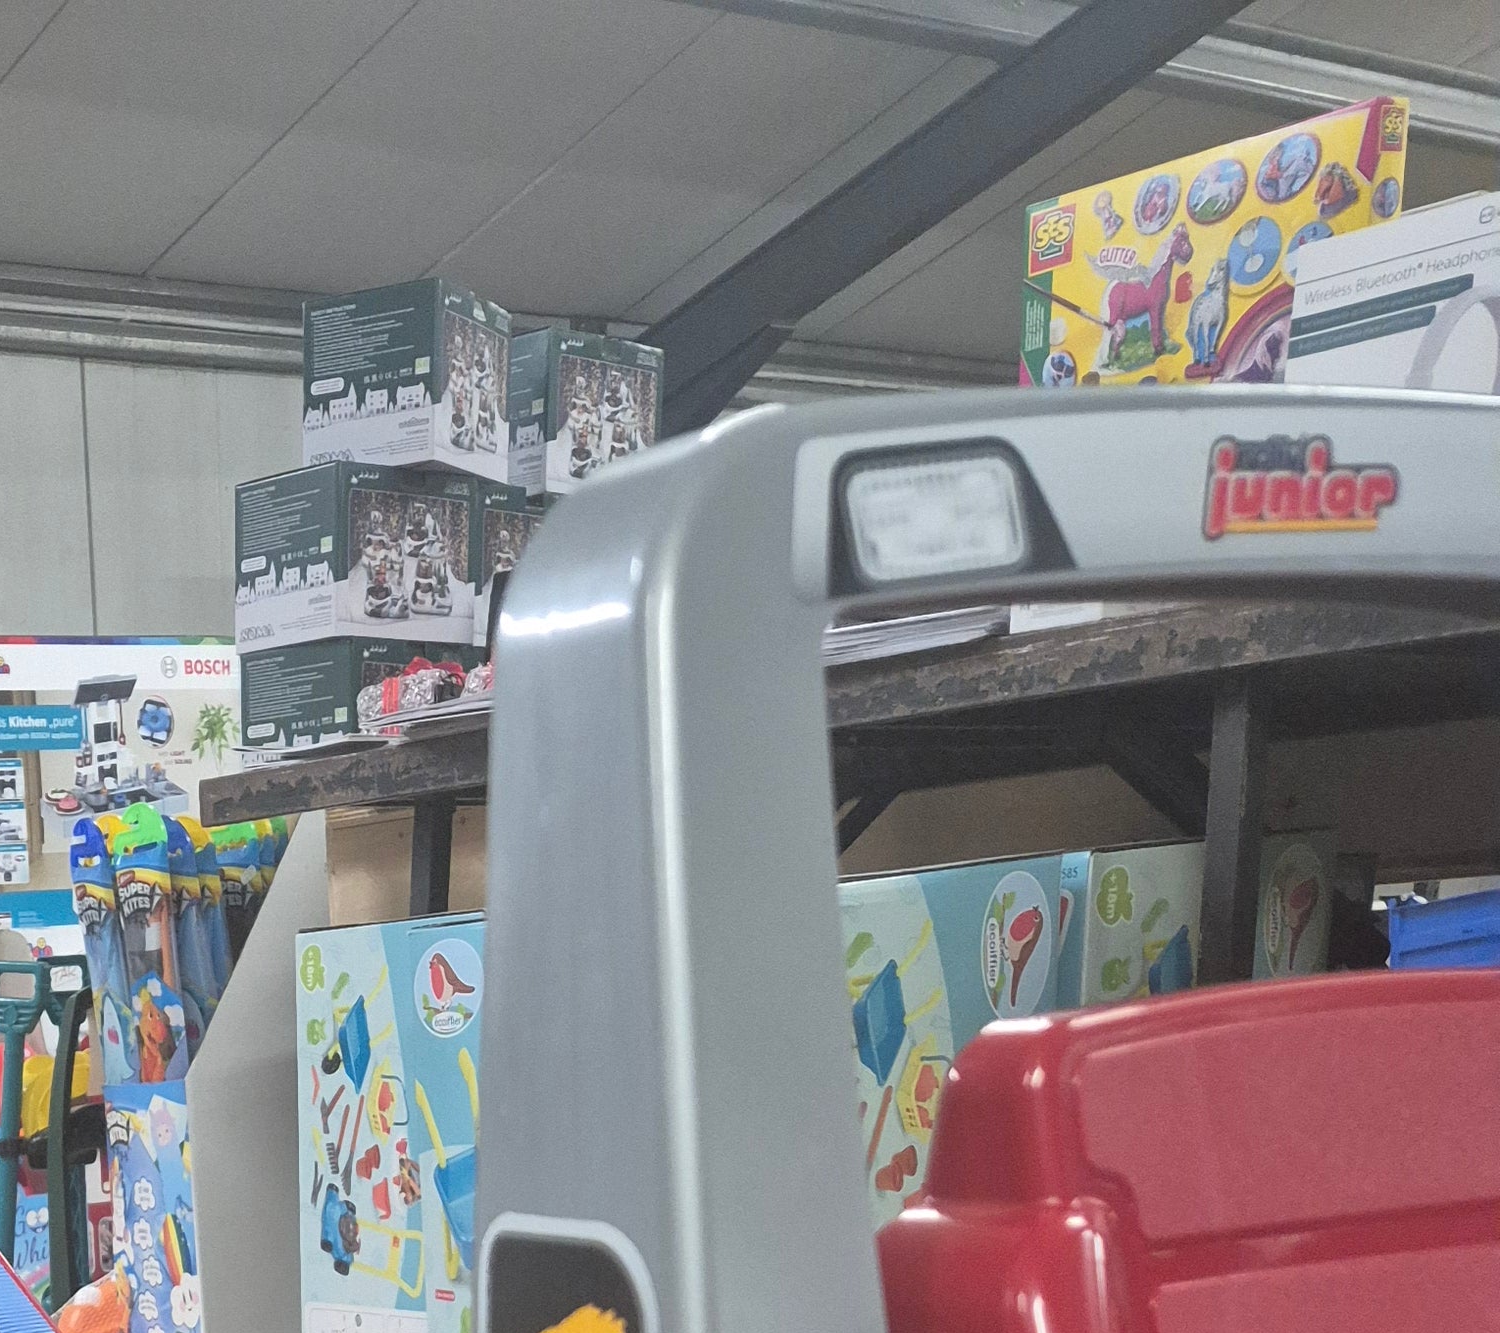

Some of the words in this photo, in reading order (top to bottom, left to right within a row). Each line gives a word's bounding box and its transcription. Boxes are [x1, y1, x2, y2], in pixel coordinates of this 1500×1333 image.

[1033, 211, 1074, 251] SES
[1100, 247, 1136, 268] GLITTER
[1304, 282, 1352, 304] Wireless
[1203, 435, 1399, 542] junior
[184, 659, 231, 675] BOSCH
[8, 715, 47, 728] Kitchen
[119, 883, 150, 900] SUPER
[122, 897, 150, 917] KITES
